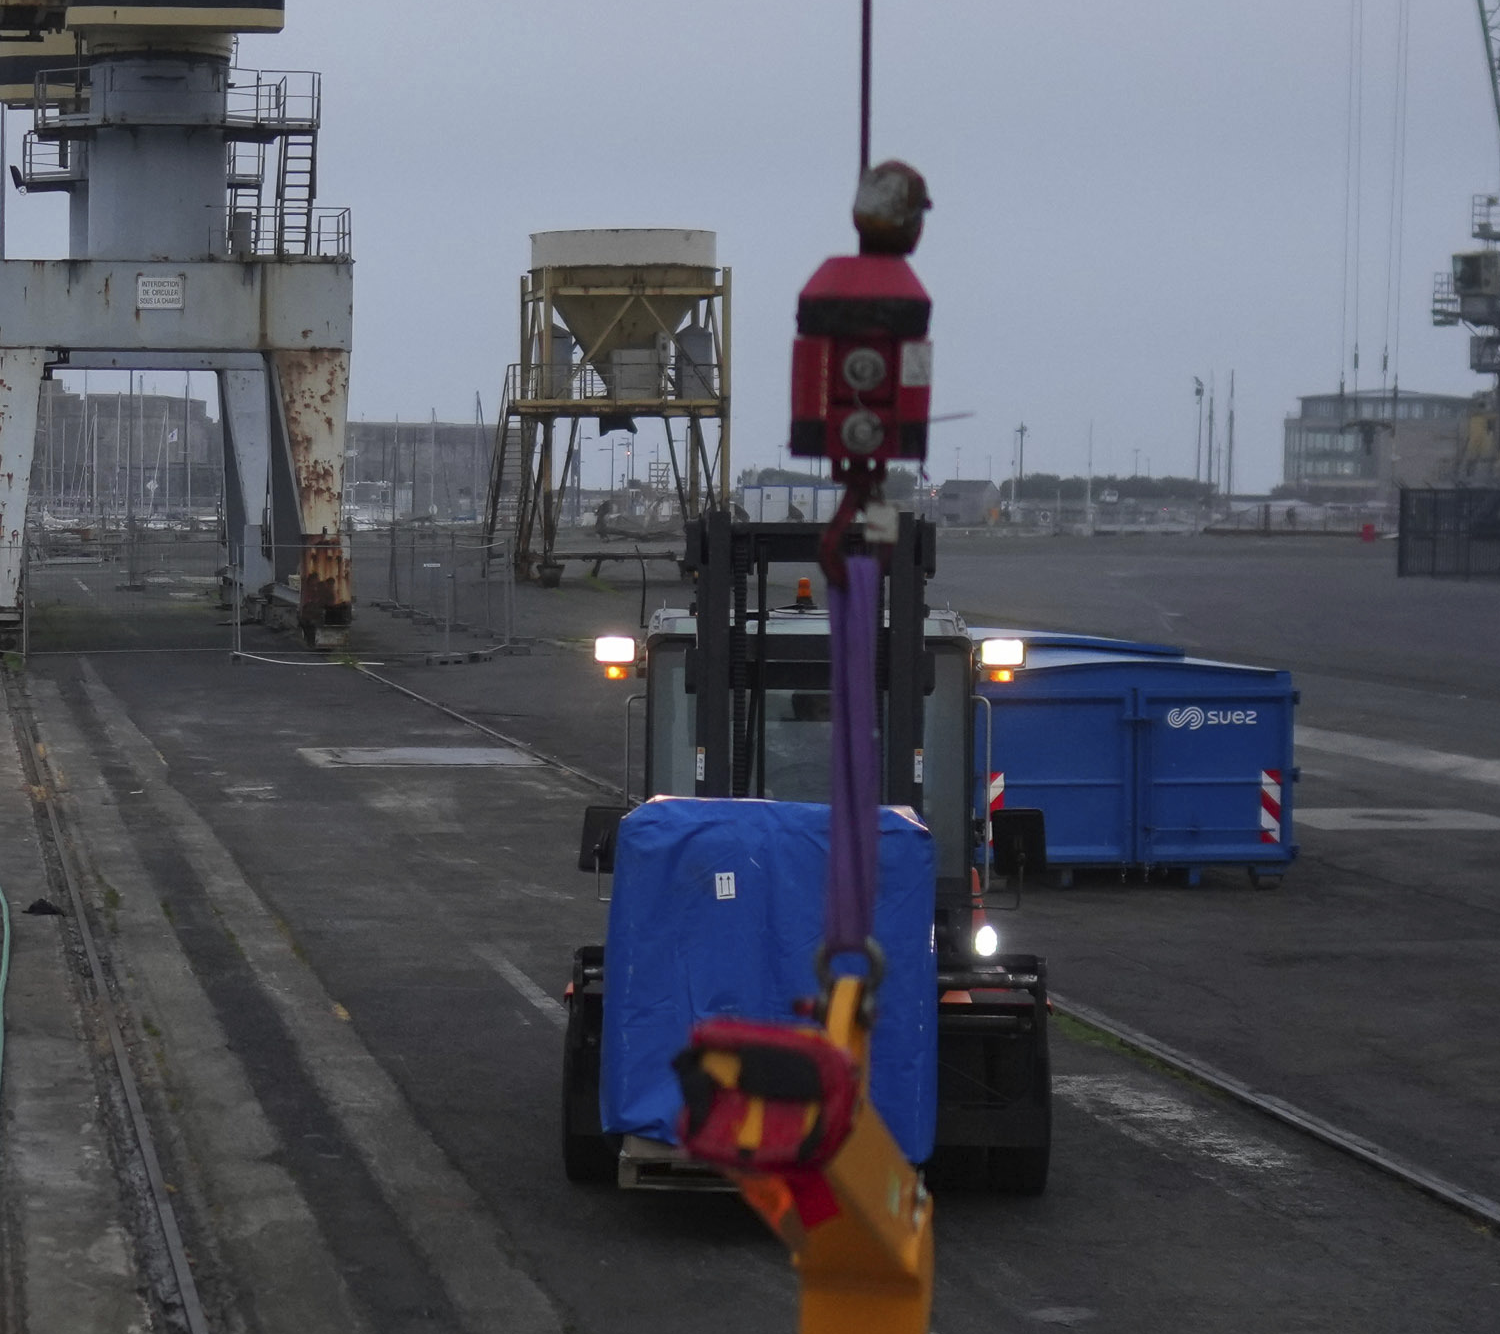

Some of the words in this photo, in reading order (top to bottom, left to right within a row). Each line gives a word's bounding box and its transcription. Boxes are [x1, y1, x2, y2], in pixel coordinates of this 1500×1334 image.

[141, 280, 180, 288] INTERDICTION
[161, 297, 181, 305] CHARGE
[1207, 710, 1257, 725] suez
